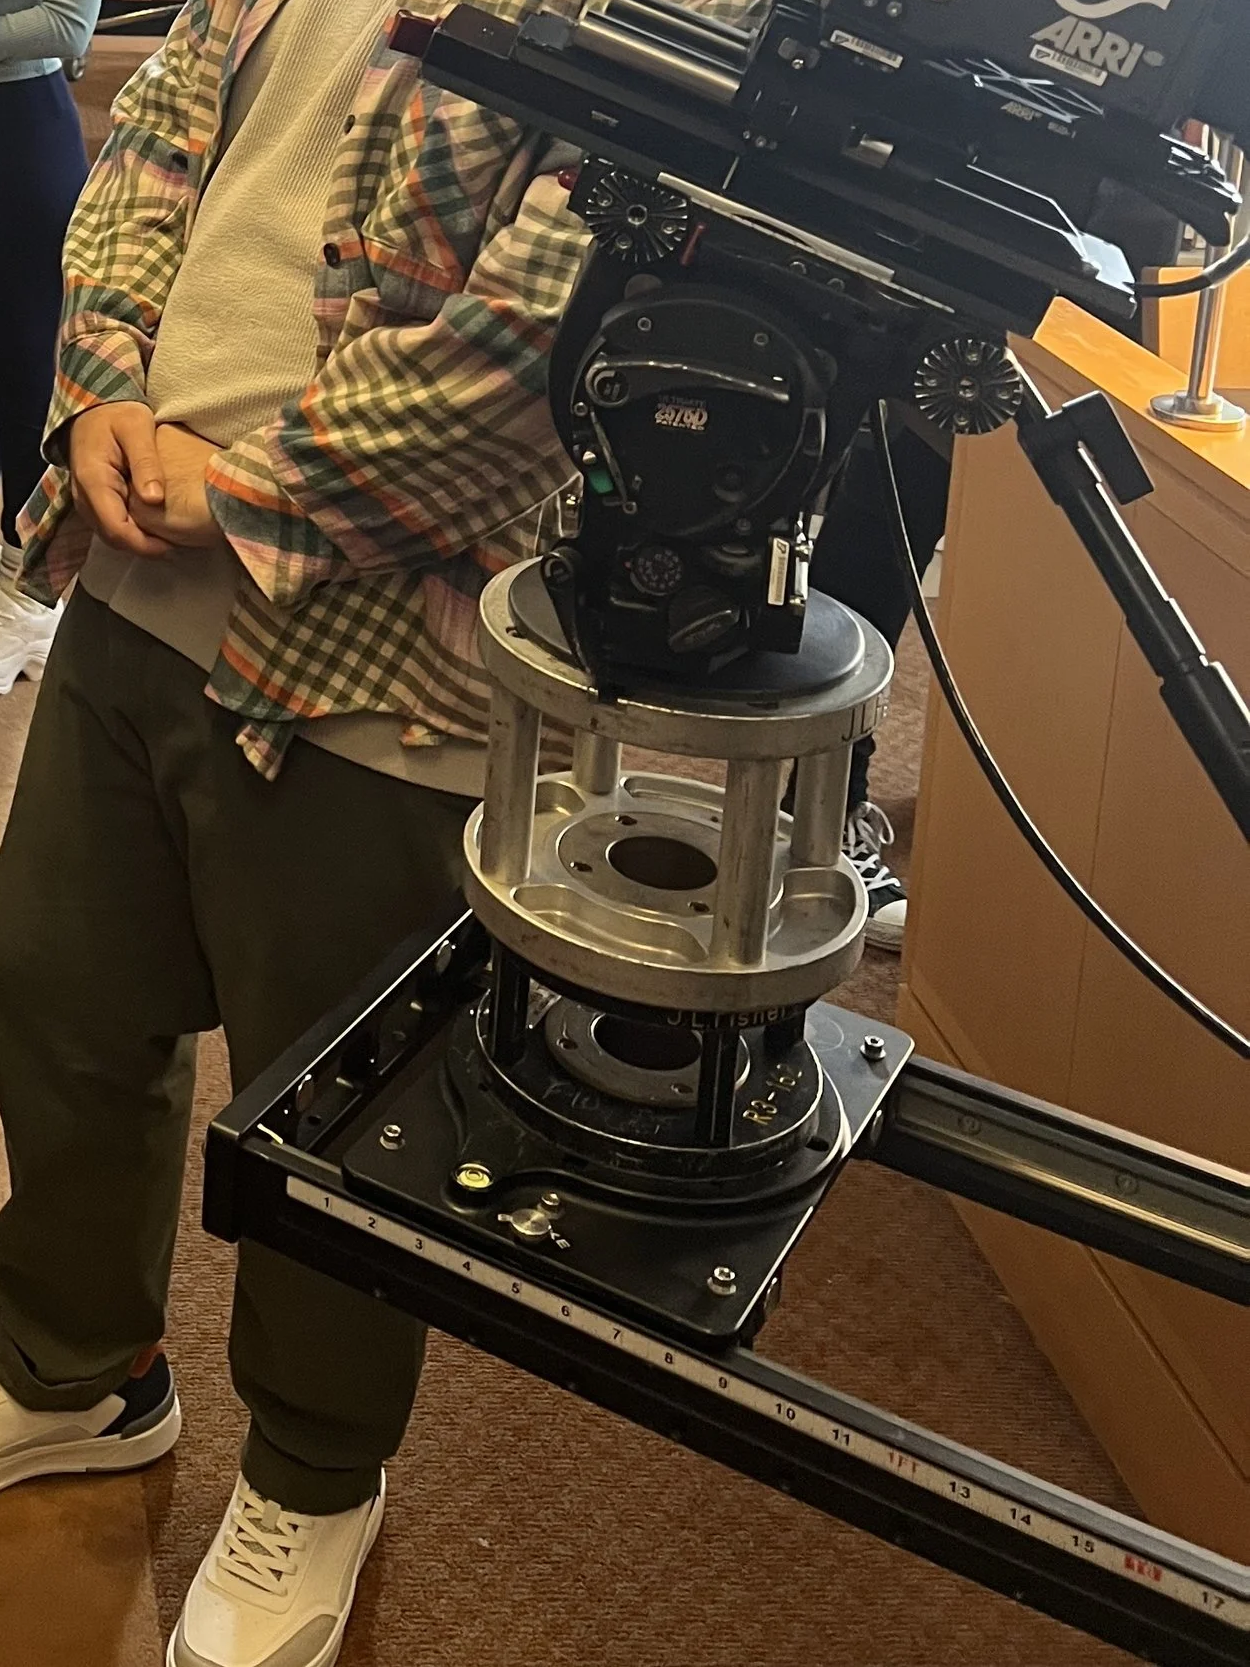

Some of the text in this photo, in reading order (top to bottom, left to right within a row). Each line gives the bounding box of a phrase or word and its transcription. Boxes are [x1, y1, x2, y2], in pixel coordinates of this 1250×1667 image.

[1030, 15, 1144, 78] ARRI
[323, 1197, 330, 1208] 1
[367, 1216, 376, 1229] 2
[414, 1238, 424, 1250] 3
[461, 1260, 471, 1272] 4
[511, 1282, 520, 1294] 5
[561, 1305, 570, 1318] 6
[612, 1328, 622, 1341] 7
[664, 1352, 673, 1365] 8
[718, 1377, 728, 1390] 9
[775, 1402, 797, 1420] 10
[831, 1427, 851, 1447] 11
[948, 1480, 972, 1500] 13
[1009, 1507, 1032, 1527] 14
[1072, 1533, 1095, 1554] 15
[1200, 1590, 1225, 1610] 17
